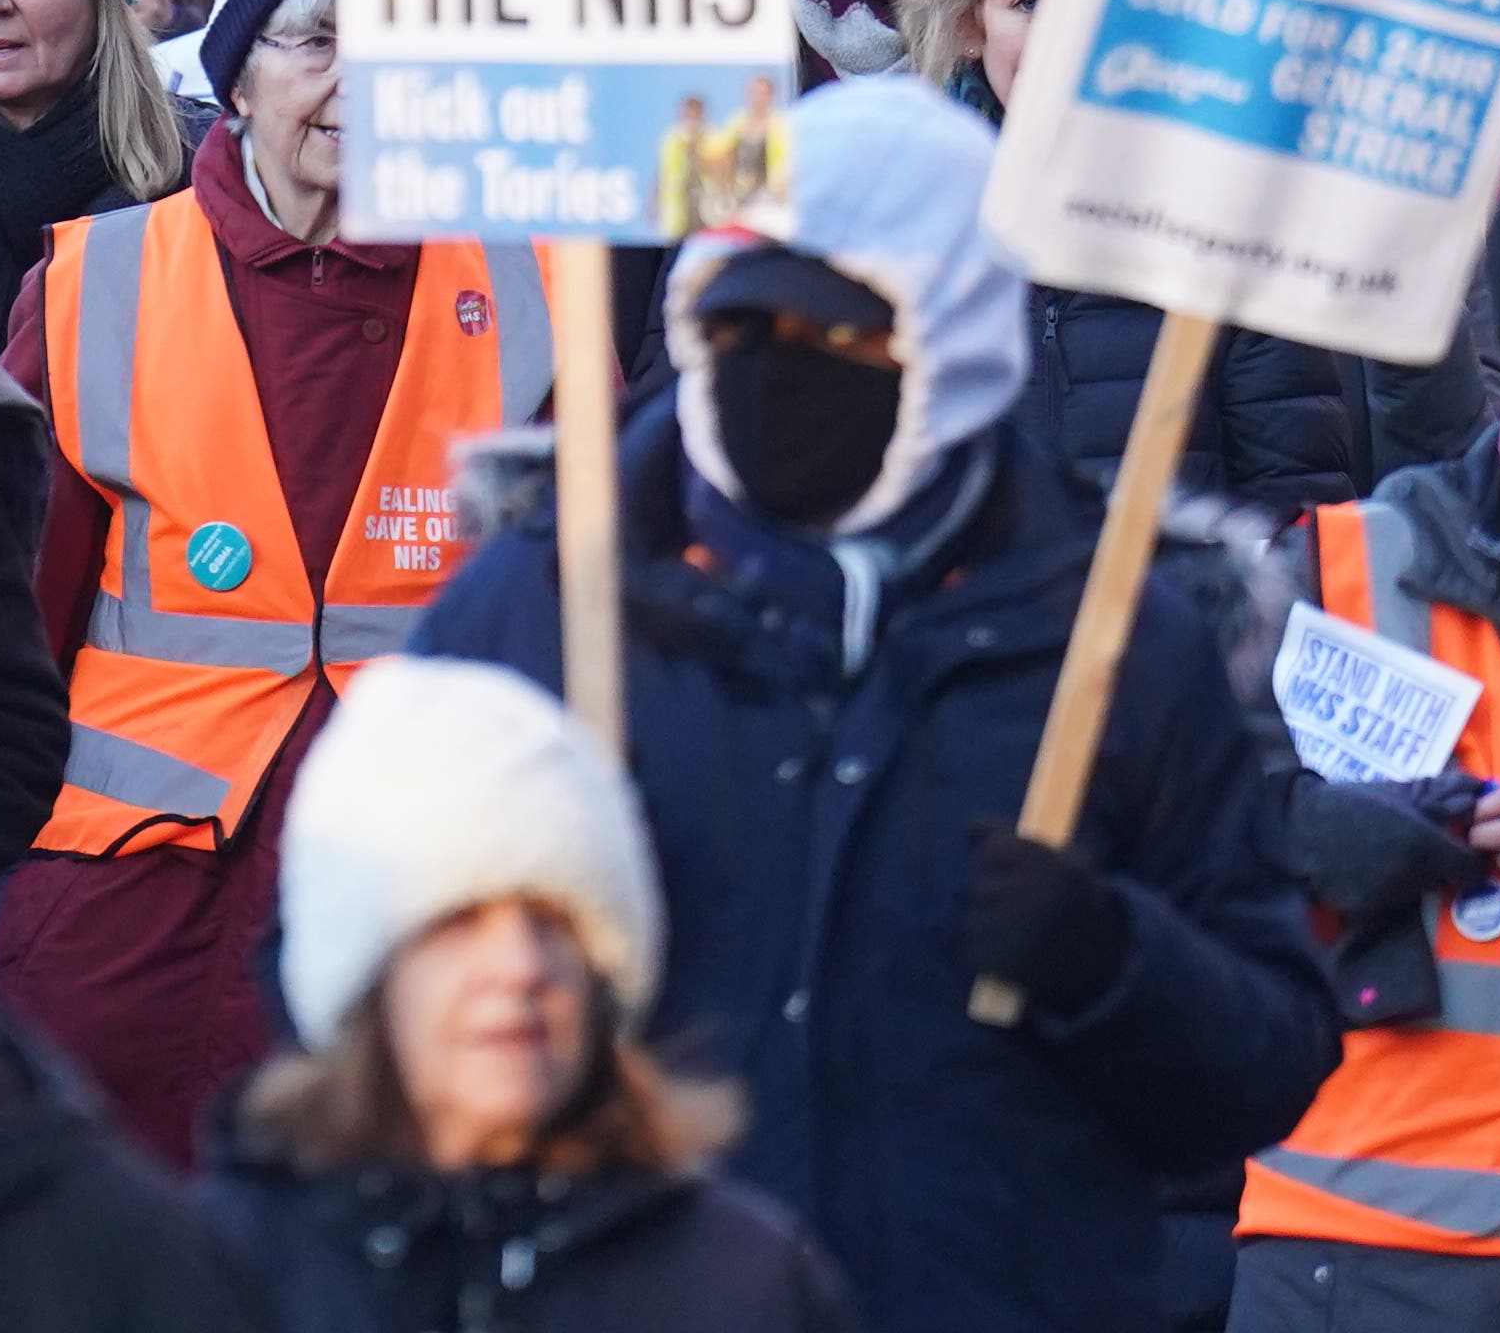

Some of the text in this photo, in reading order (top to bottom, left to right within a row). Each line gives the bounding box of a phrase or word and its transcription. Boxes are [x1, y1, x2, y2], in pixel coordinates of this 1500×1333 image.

[379, 486, 458, 513] EALING
[364, 516, 417, 541] SAVE
[395, 546, 442, 571] NHS
[1301, 639, 1446, 721] STAND WITH
[1288, 675, 1344, 722] NHS
[1341, 705, 1426, 763] STAFF
